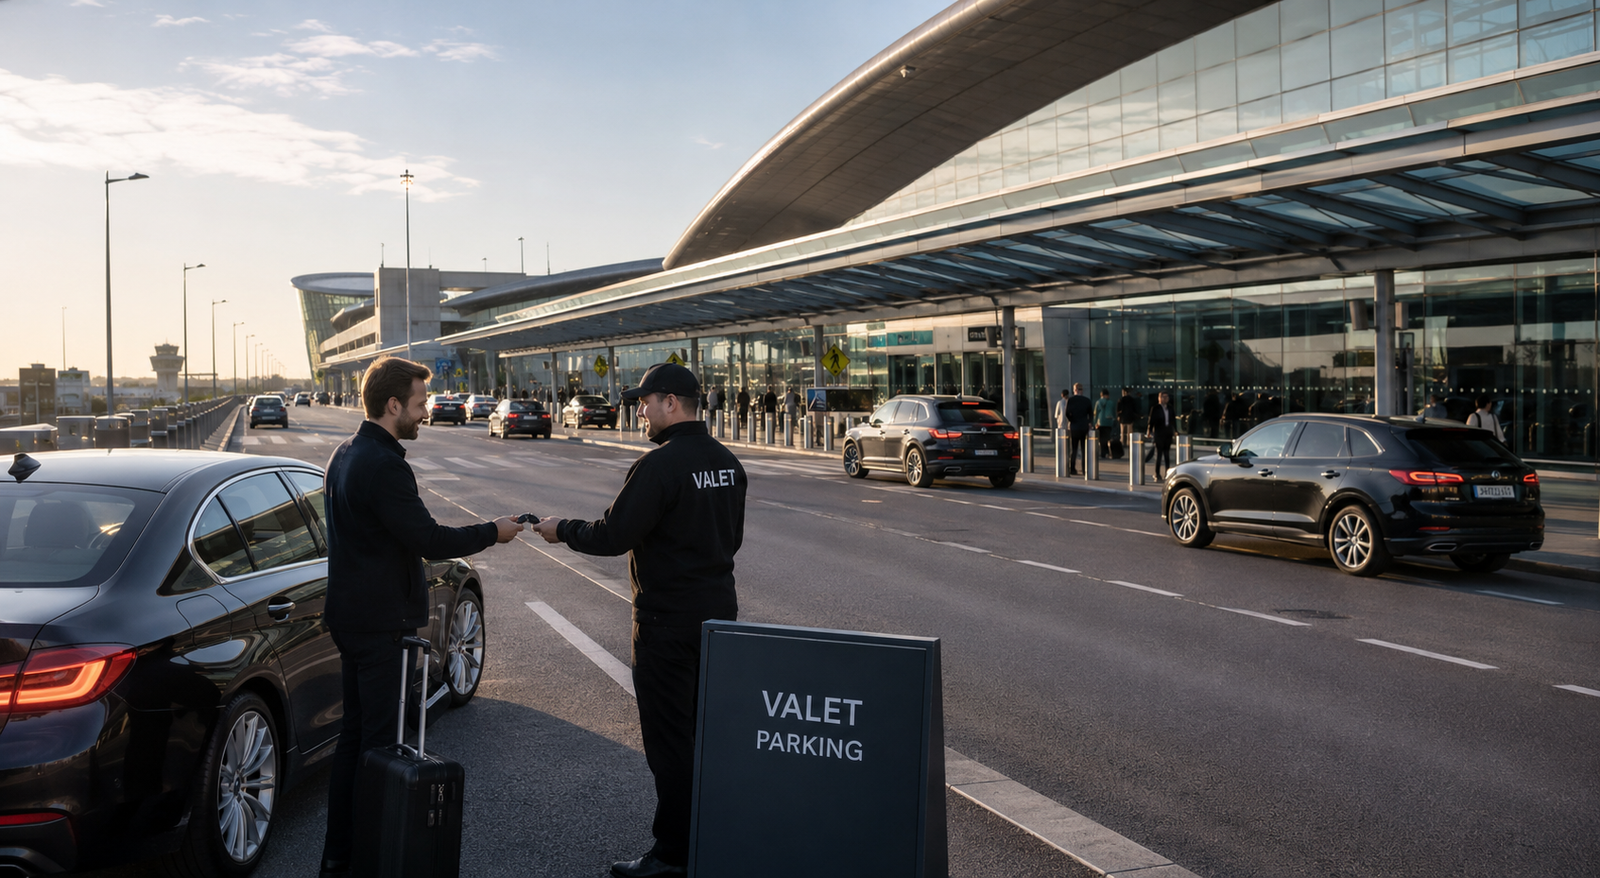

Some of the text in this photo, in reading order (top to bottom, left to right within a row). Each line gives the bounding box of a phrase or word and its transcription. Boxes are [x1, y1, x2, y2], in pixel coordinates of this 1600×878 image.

[692, 469, 735, 489] VALET
[762, 690, 863, 726] VALET
[757, 729, 863, 762] PARKING
